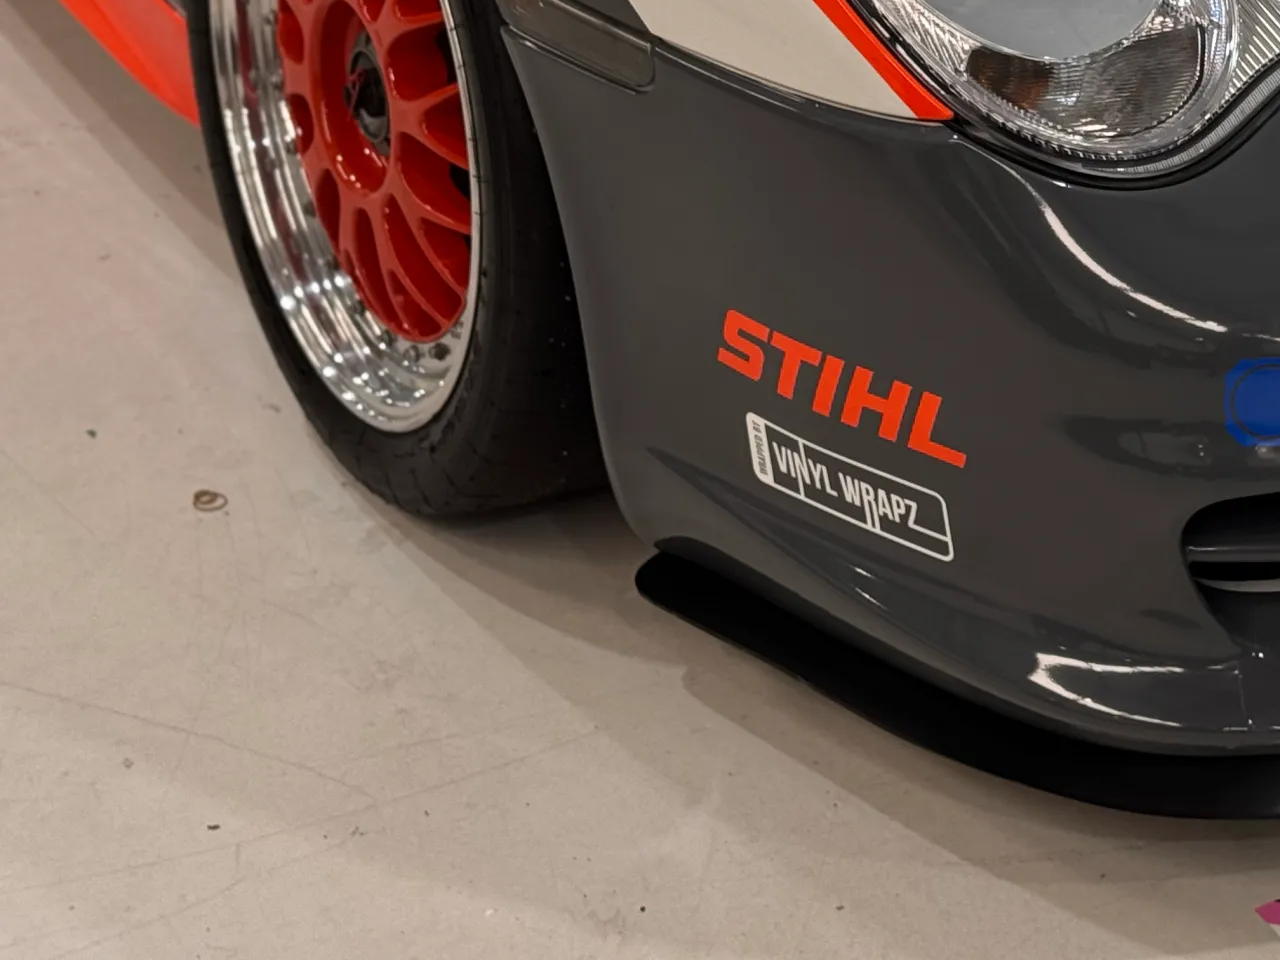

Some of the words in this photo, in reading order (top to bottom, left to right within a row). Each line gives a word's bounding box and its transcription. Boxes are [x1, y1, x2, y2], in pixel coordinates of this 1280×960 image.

[717, 309, 967, 468] STIHL
[772, 440, 838, 498] VINYL
[839, 471, 920, 530] WRAPZ
